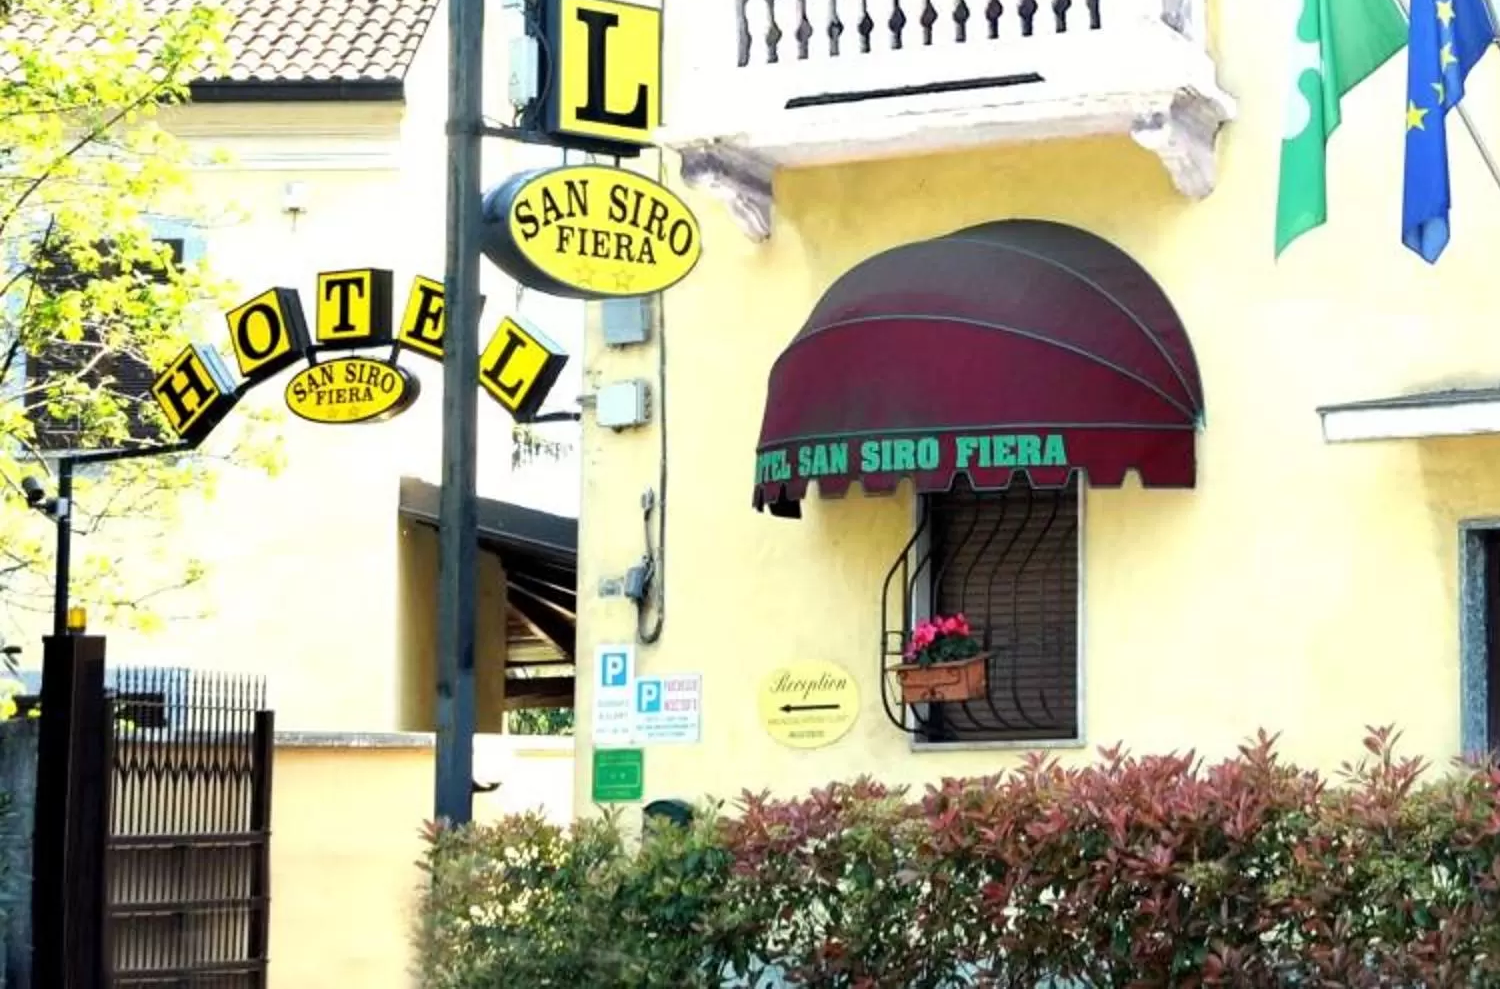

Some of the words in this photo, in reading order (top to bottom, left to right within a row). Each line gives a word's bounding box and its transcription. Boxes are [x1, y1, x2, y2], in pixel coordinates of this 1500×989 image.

[514, 179, 589, 242] SAN
[608, 183, 693, 256] SIRO
[556, 224, 657, 265] FIERA
[156, 277, 525, 430] HOTEL
[293, 366, 334, 404] SAN
[345, 363, 396, 395] SIRO
[315, 387, 375, 406] FIERA
[755, 449, 791, 483] TEL
[798, 442, 848, 476] SAN
[861, 438, 939, 472] SIRO
[955, 434, 1067, 468] FIERA
[605, 655, 625, 685] P
[770, 670, 847, 700] Reception
[640, 683, 659, 712] P
